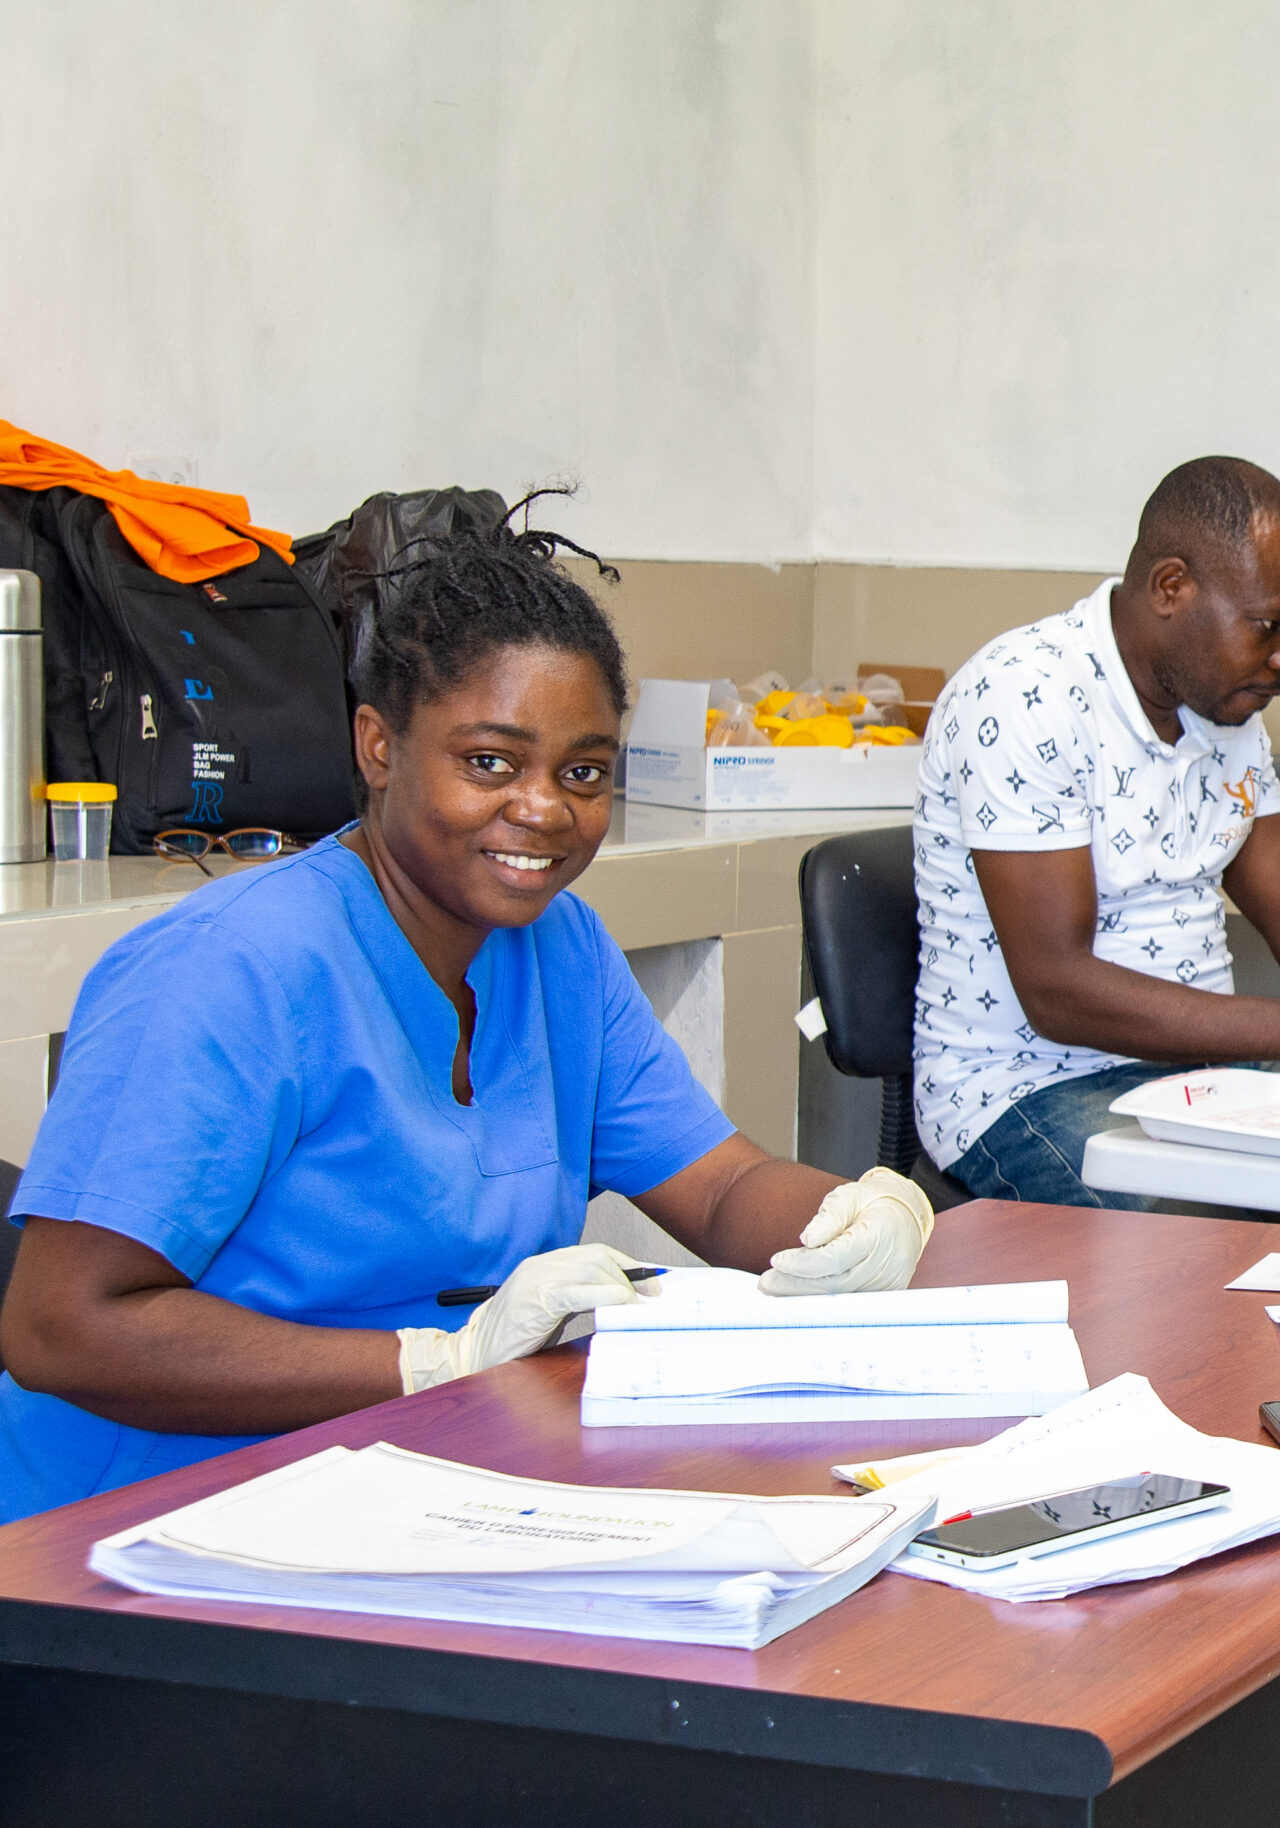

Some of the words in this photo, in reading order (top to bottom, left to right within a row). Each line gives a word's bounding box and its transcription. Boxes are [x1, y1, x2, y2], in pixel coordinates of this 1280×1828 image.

[193, 743, 218, 752] SPORT
[210, 753, 235, 763] POWER
[713, 756, 746, 766] NIPRO
[193, 760, 211, 770] BAG
[193, 769, 225, 780] FASHION
[424, 1512, 487, 1526] CAHIER
[485, 1528, 601, 1543] LABORATOIRE
